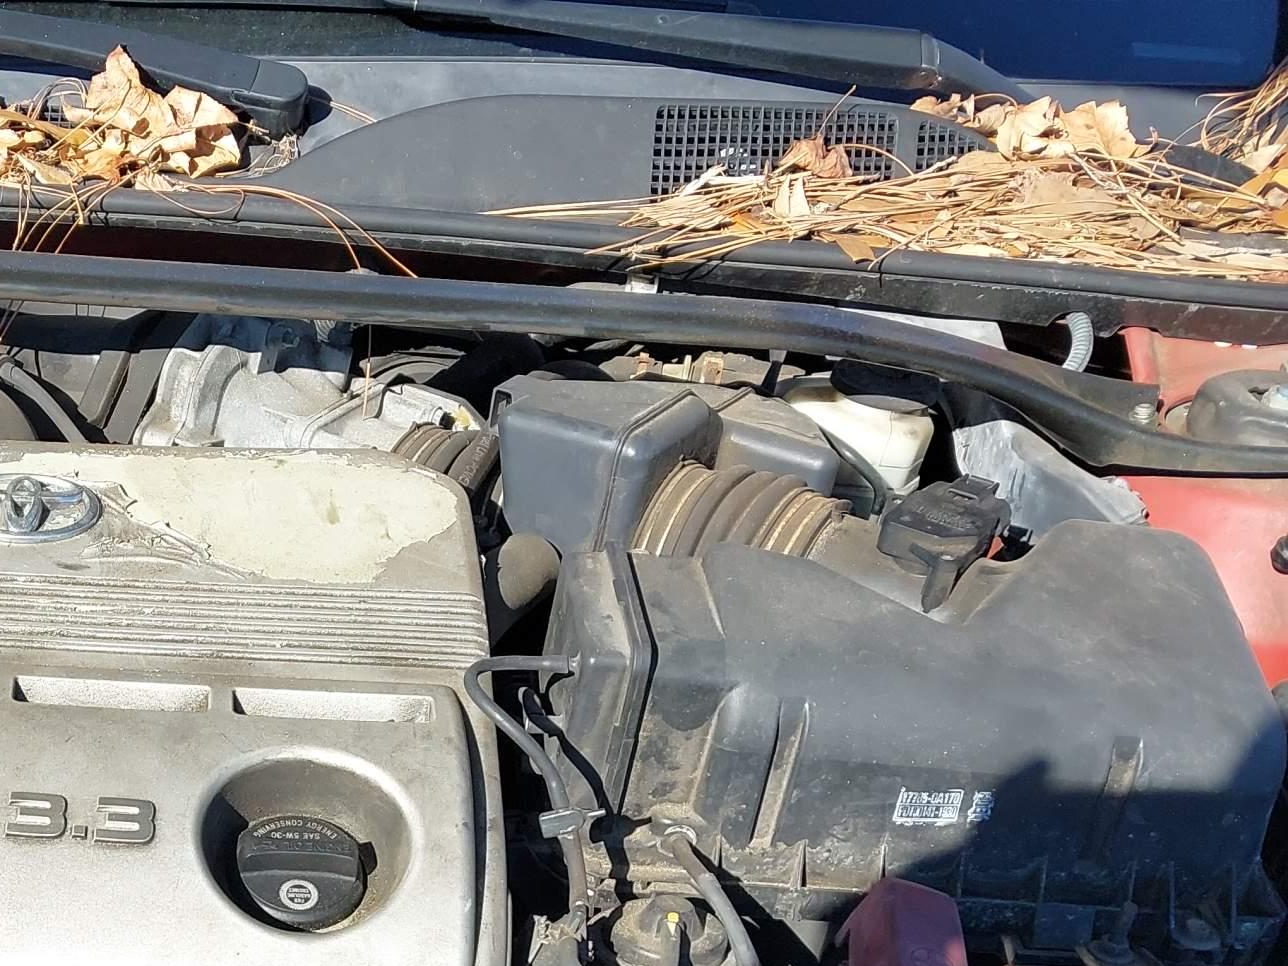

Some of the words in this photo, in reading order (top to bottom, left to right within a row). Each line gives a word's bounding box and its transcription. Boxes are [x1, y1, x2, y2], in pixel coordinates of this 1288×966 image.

[4, 791, 156, 843] 3.3
[253, 819, 303, 838] CONSERVING
[303, 832, 321, 840] SAE
[305, 820, 338, 840] ENERGY
